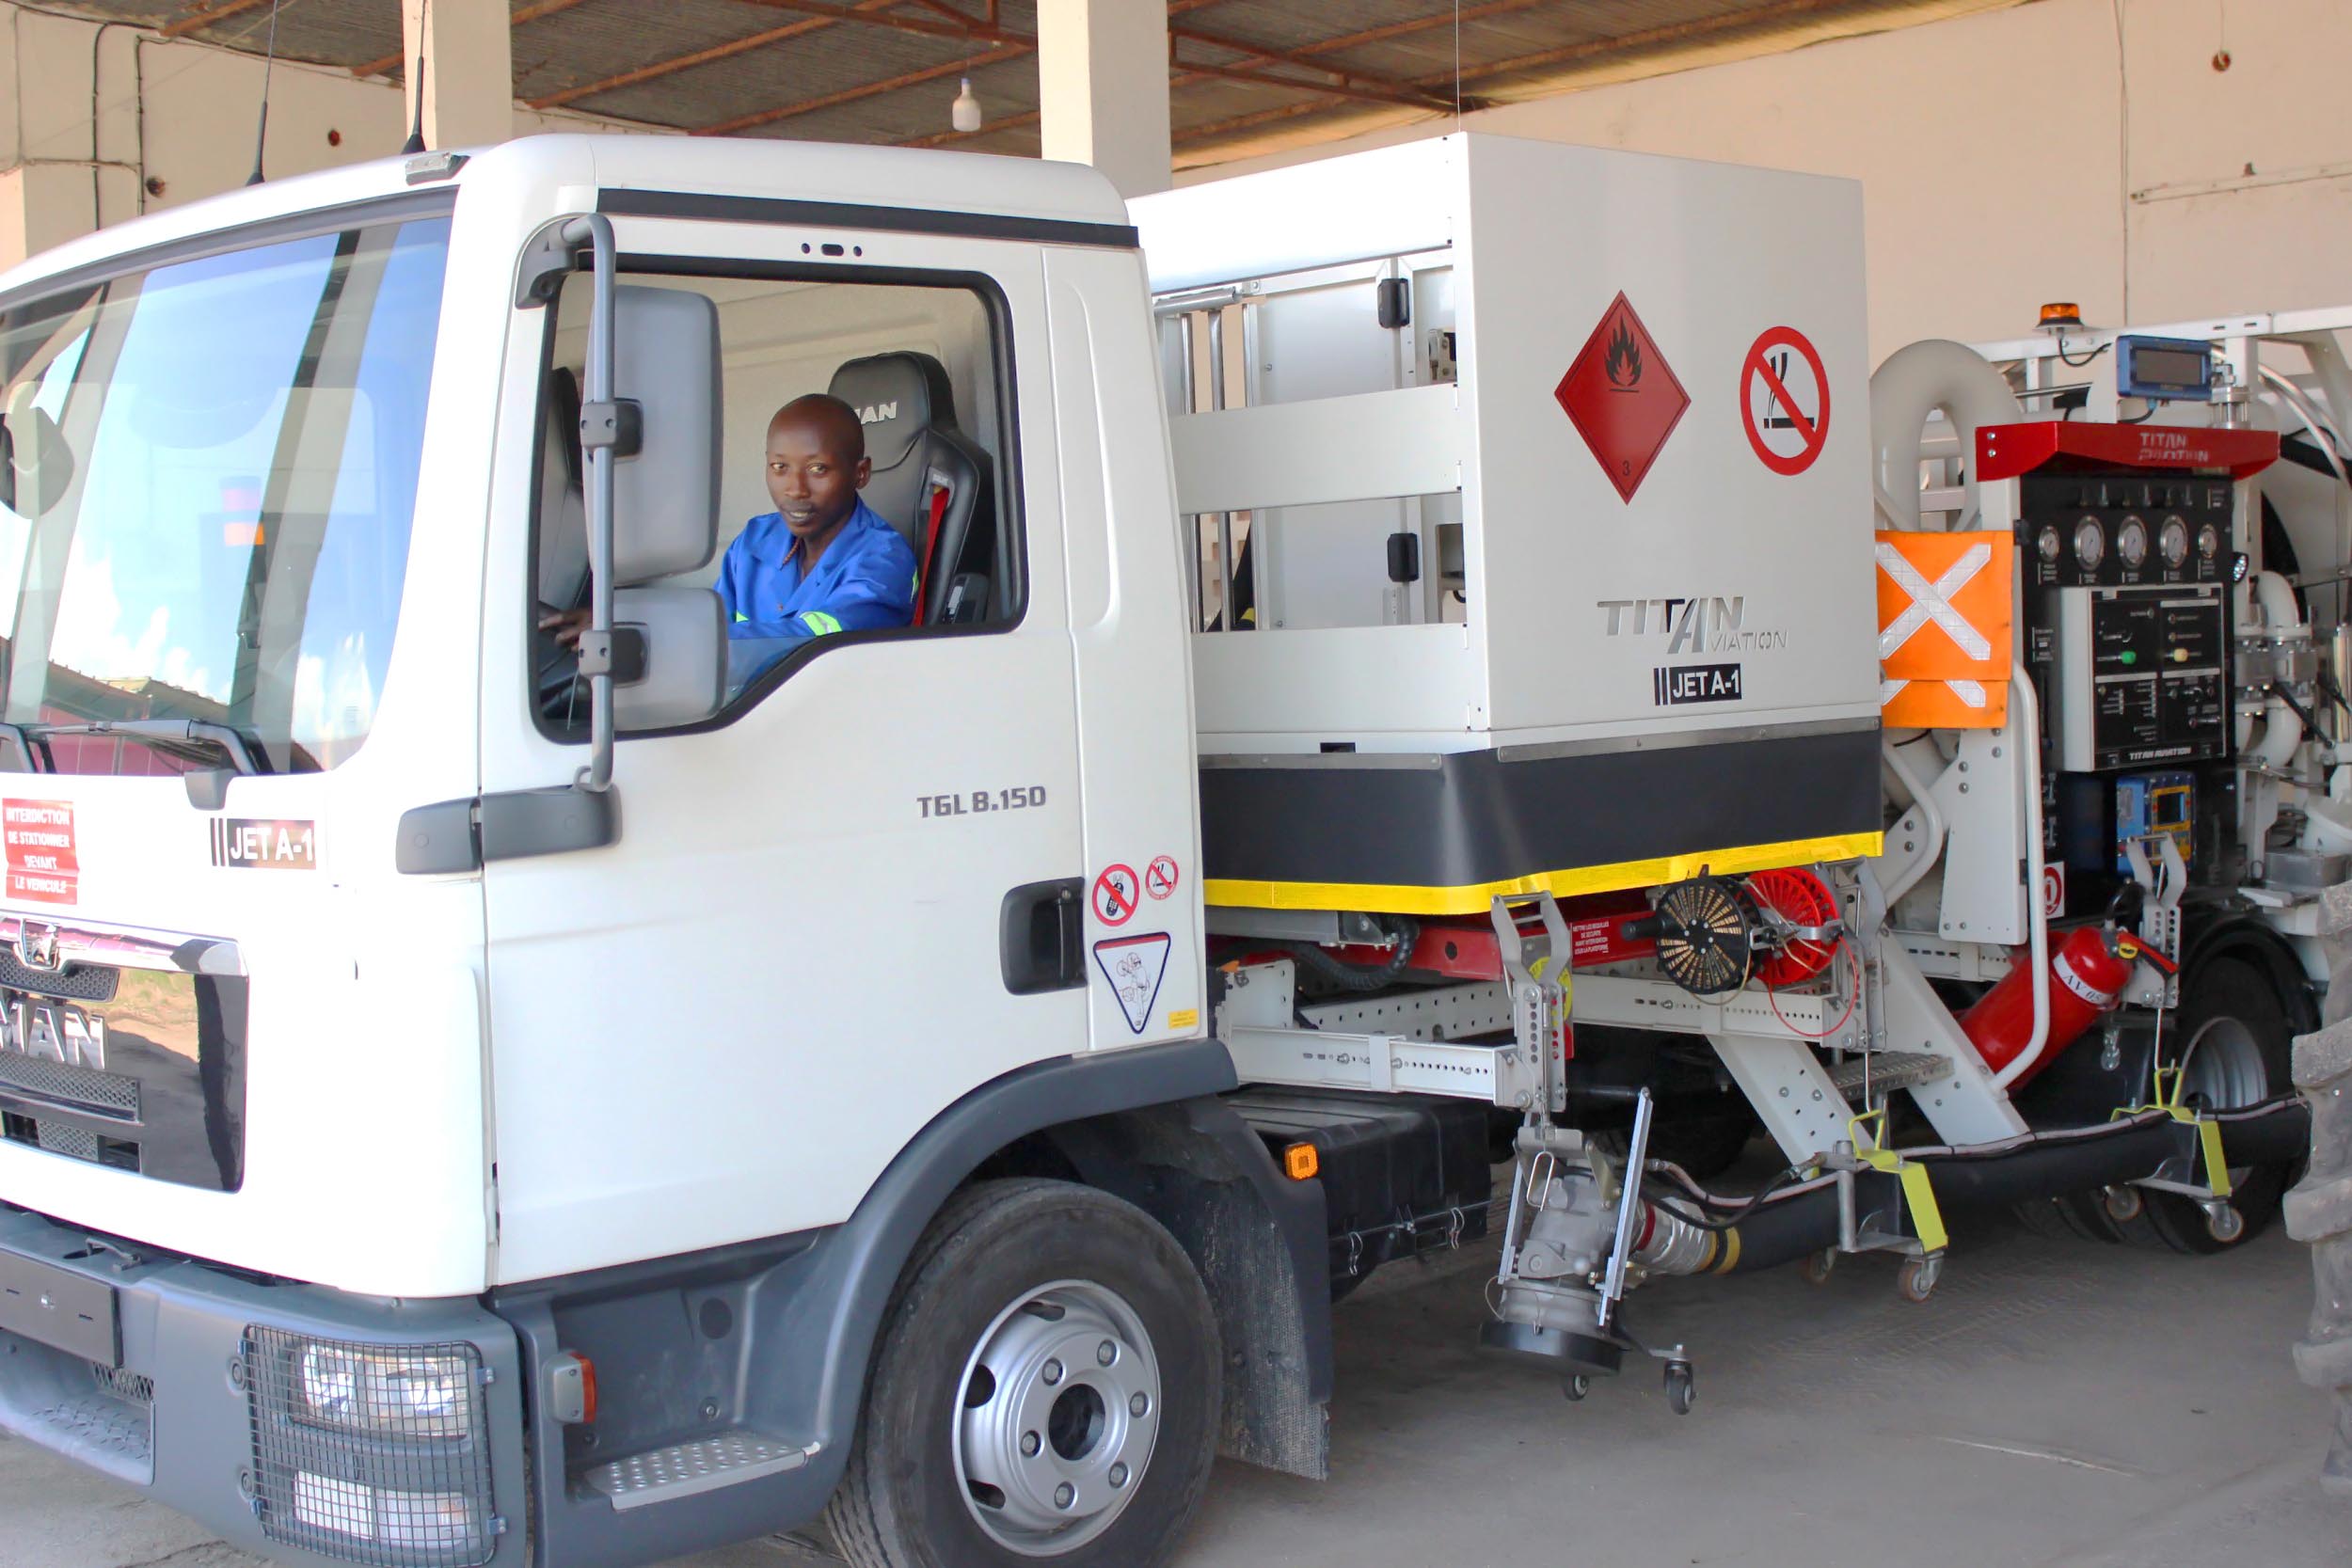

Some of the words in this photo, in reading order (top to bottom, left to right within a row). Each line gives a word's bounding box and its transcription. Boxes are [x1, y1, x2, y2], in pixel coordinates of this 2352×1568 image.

[854, 401, 897, 424] AN
[2139, 432, 2187, 448] TITAN
[1622, 460, 1630, 476] 3
[1597, 595, 1745, 655] TITAN
[1672, 671, 1708, 698] JET
[1710, 669, 1740, 695] A-1
[916, 794, 967, 818] TGL
[972, 785, 1046, 813] 8.150
[6, 807, 70, 825] INTERDICTION
[8, 831, 18, 844] DE
[19, 832, 70, 848] STATIONNER
[230, 827, 272, 860] JET
[275, 828, 313, 862] A-1
[24, 854, 56, 870] DEVANT
[15, 876, 24, 890] LE
[0, 1000, 107, 1069] MAN
